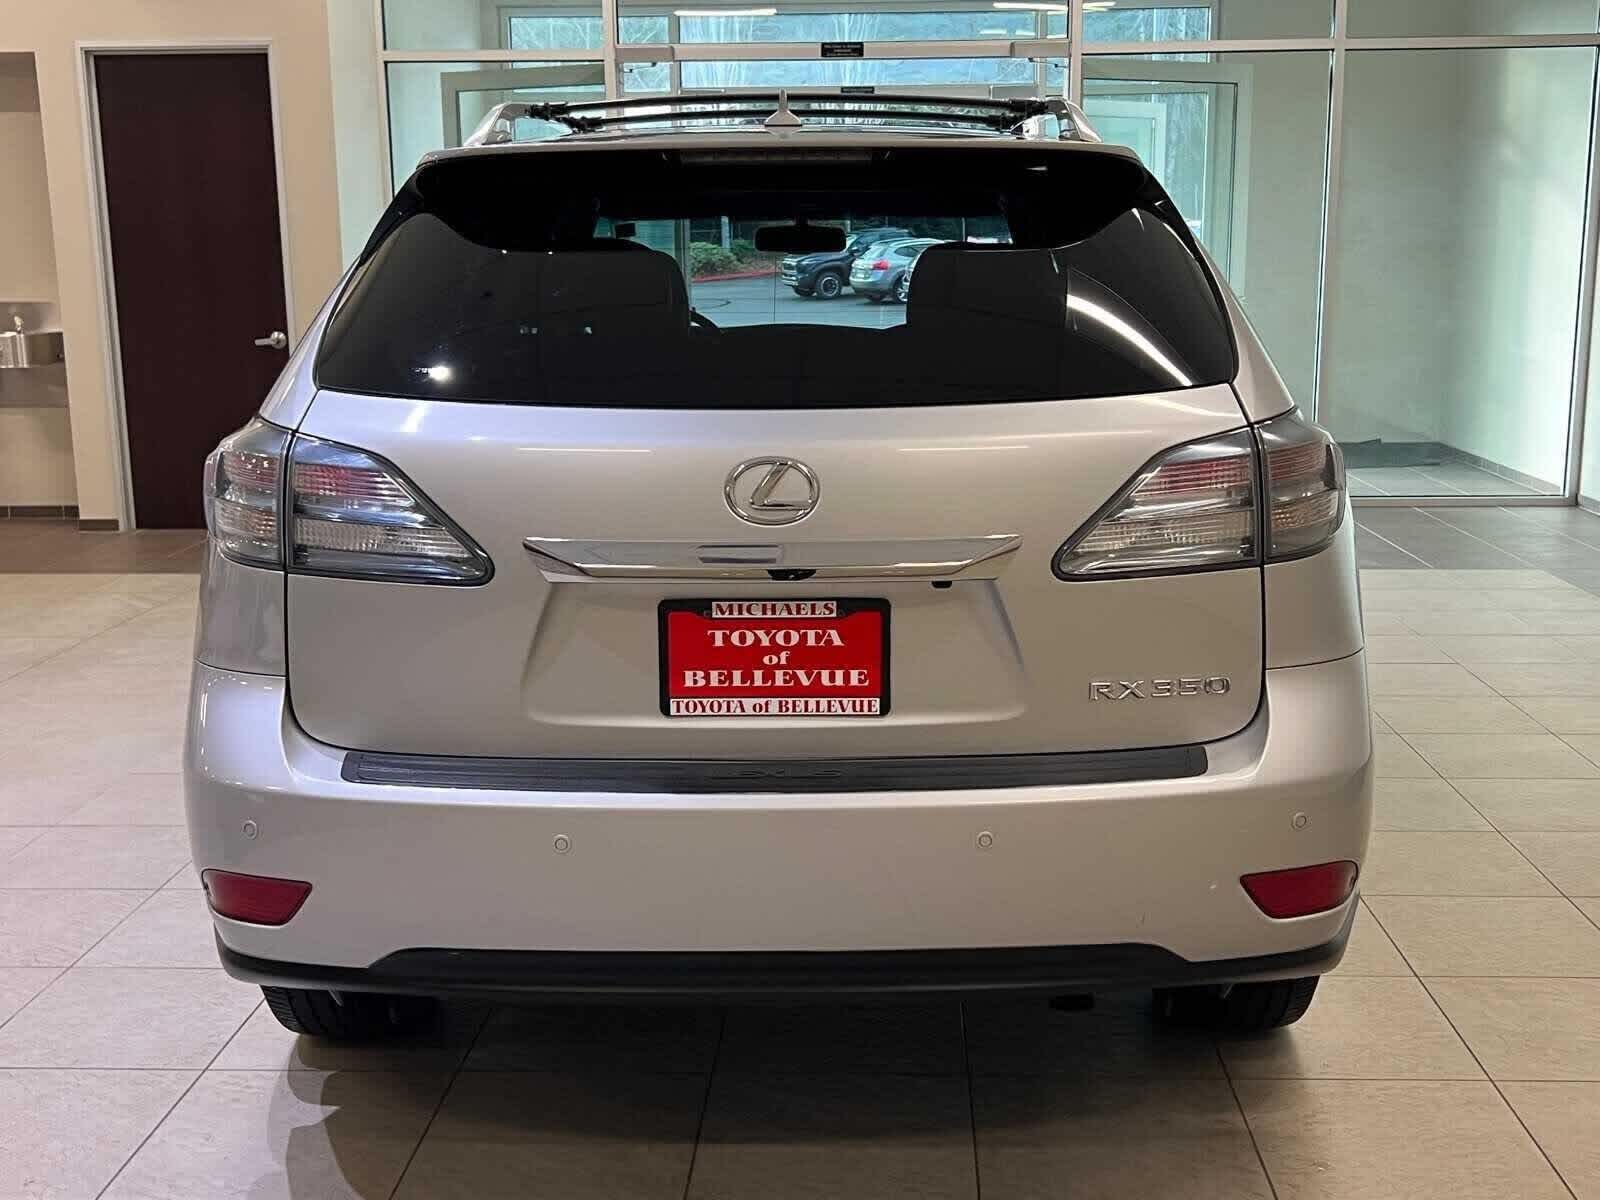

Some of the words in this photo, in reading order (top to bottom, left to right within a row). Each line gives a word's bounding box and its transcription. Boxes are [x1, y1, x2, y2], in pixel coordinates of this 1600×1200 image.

[714, 603, 835, 616] MICHAELS
[708, 629, 844, 646] TOYOTA
[763, 651, 790, 665] of
[684, 670, 869, 687] BELLEVUE
[671, 700, 745, 714] TOYOTA
[752, 700, 771, 714] of
[778, 700, 879, 714] BELLEVUE
